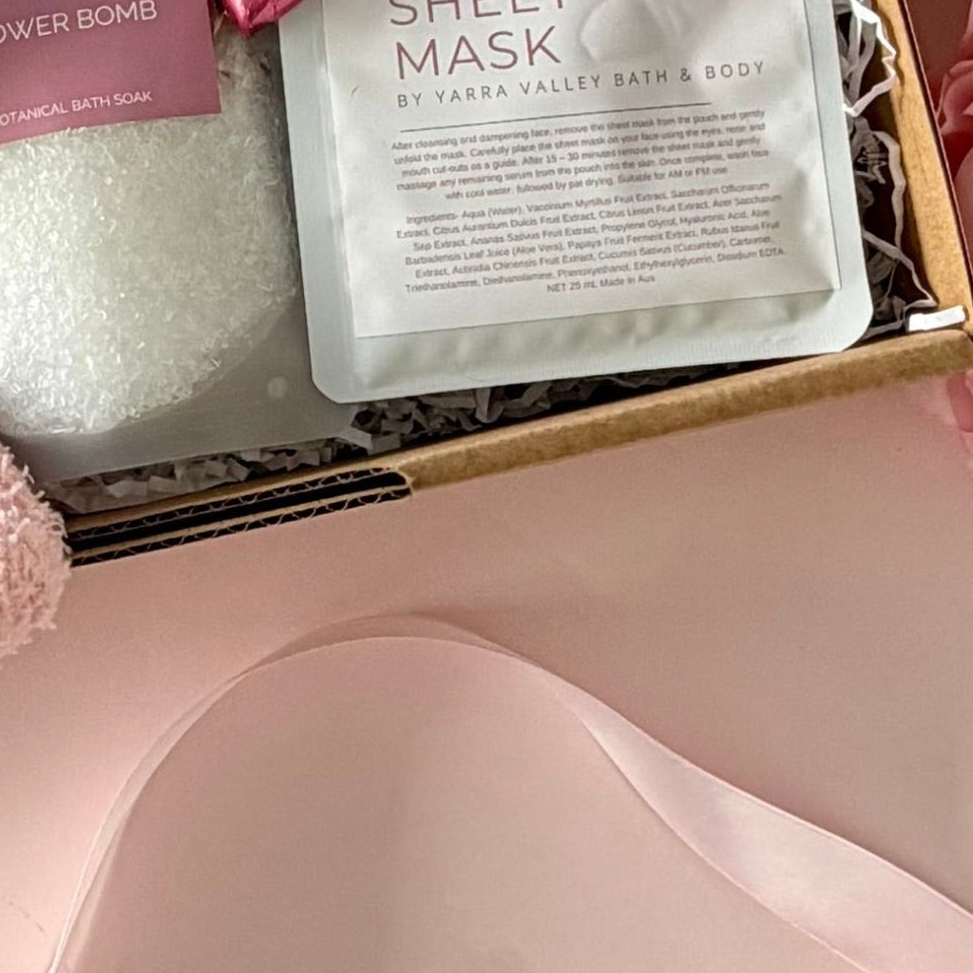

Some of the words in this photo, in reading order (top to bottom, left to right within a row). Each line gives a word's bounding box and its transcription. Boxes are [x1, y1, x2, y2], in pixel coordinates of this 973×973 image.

[77, 0, 158, 30] BOMB
[396, 25, 561, 80] MASK
[72, 95, 111, 113] BATH
[114, 90, 153, 107] SOAK
[397, 92, 422, 108] BY
[435, 82, 508, 104] YARRA
[520, 74, 601, 95] VALLEY
[614, 69, 668, 88] BATH
[680, 67, 692, 82] &
[705, 60, 765, 80] BODY
